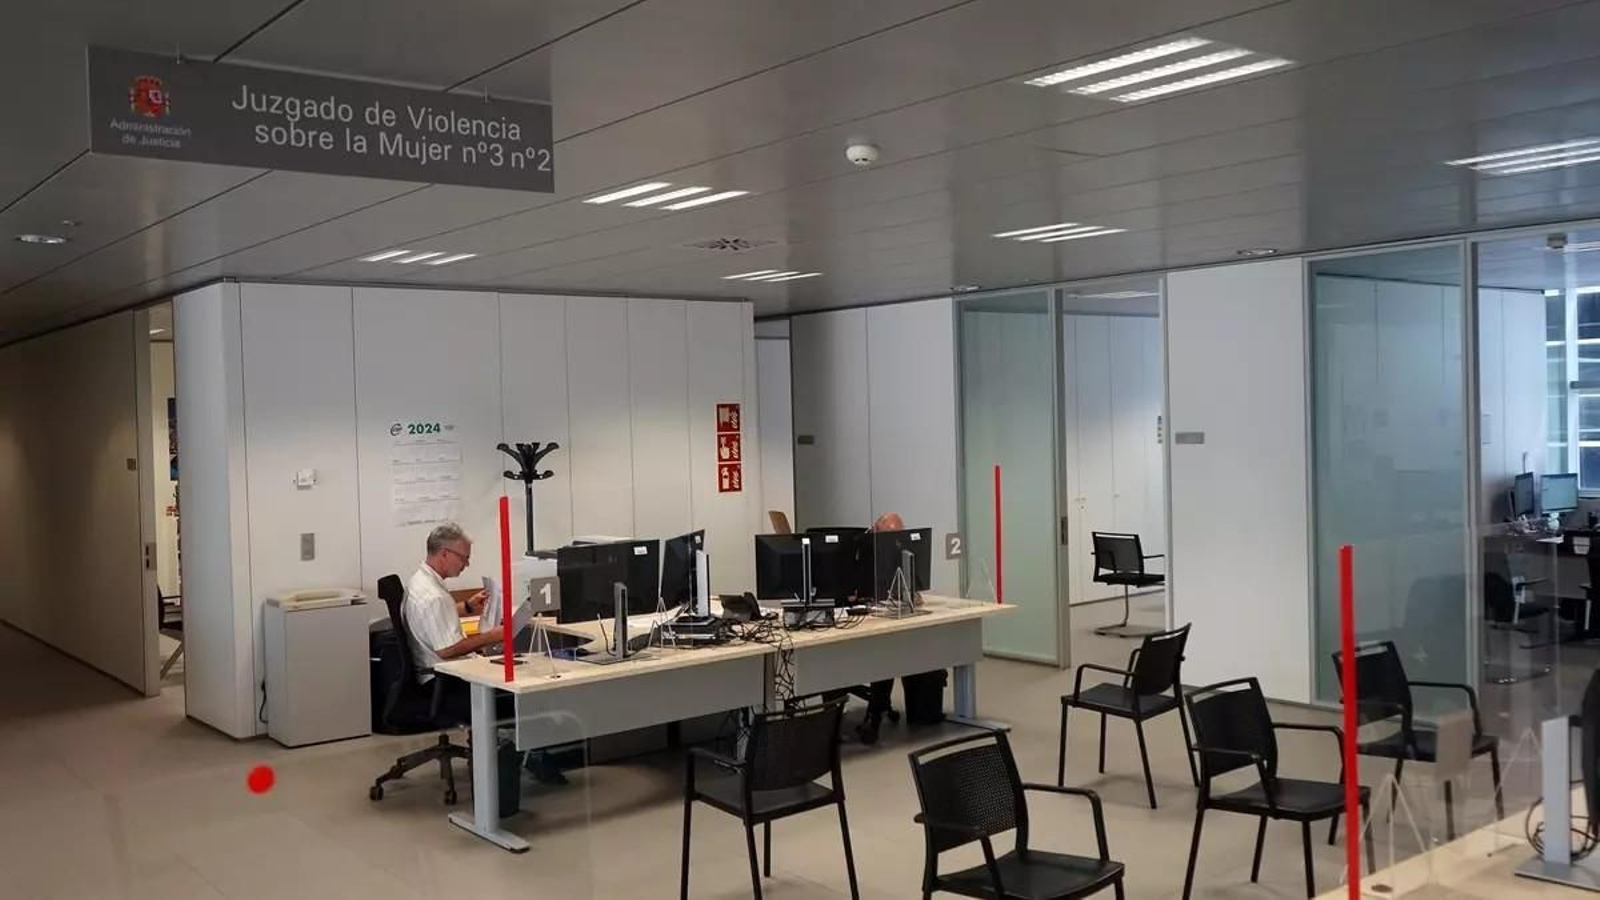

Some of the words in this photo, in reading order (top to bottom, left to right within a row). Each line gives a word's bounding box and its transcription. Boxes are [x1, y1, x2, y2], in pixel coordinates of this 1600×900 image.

[232, 84, 353, 122] Juzgado
[365, 101, 396, 127] de
[407, 105, 521, 140] Violencia
[140, 135, 181, 148] Justicia
[255, 121, 334, 150] sobre
[345, 127, 367, 153] la
[379, 131, 452, 165] Mujer
[407, 423, 441, 435] 2024
[950, 537, 961, 554] 2
[540, 583, 551, 604] 1
